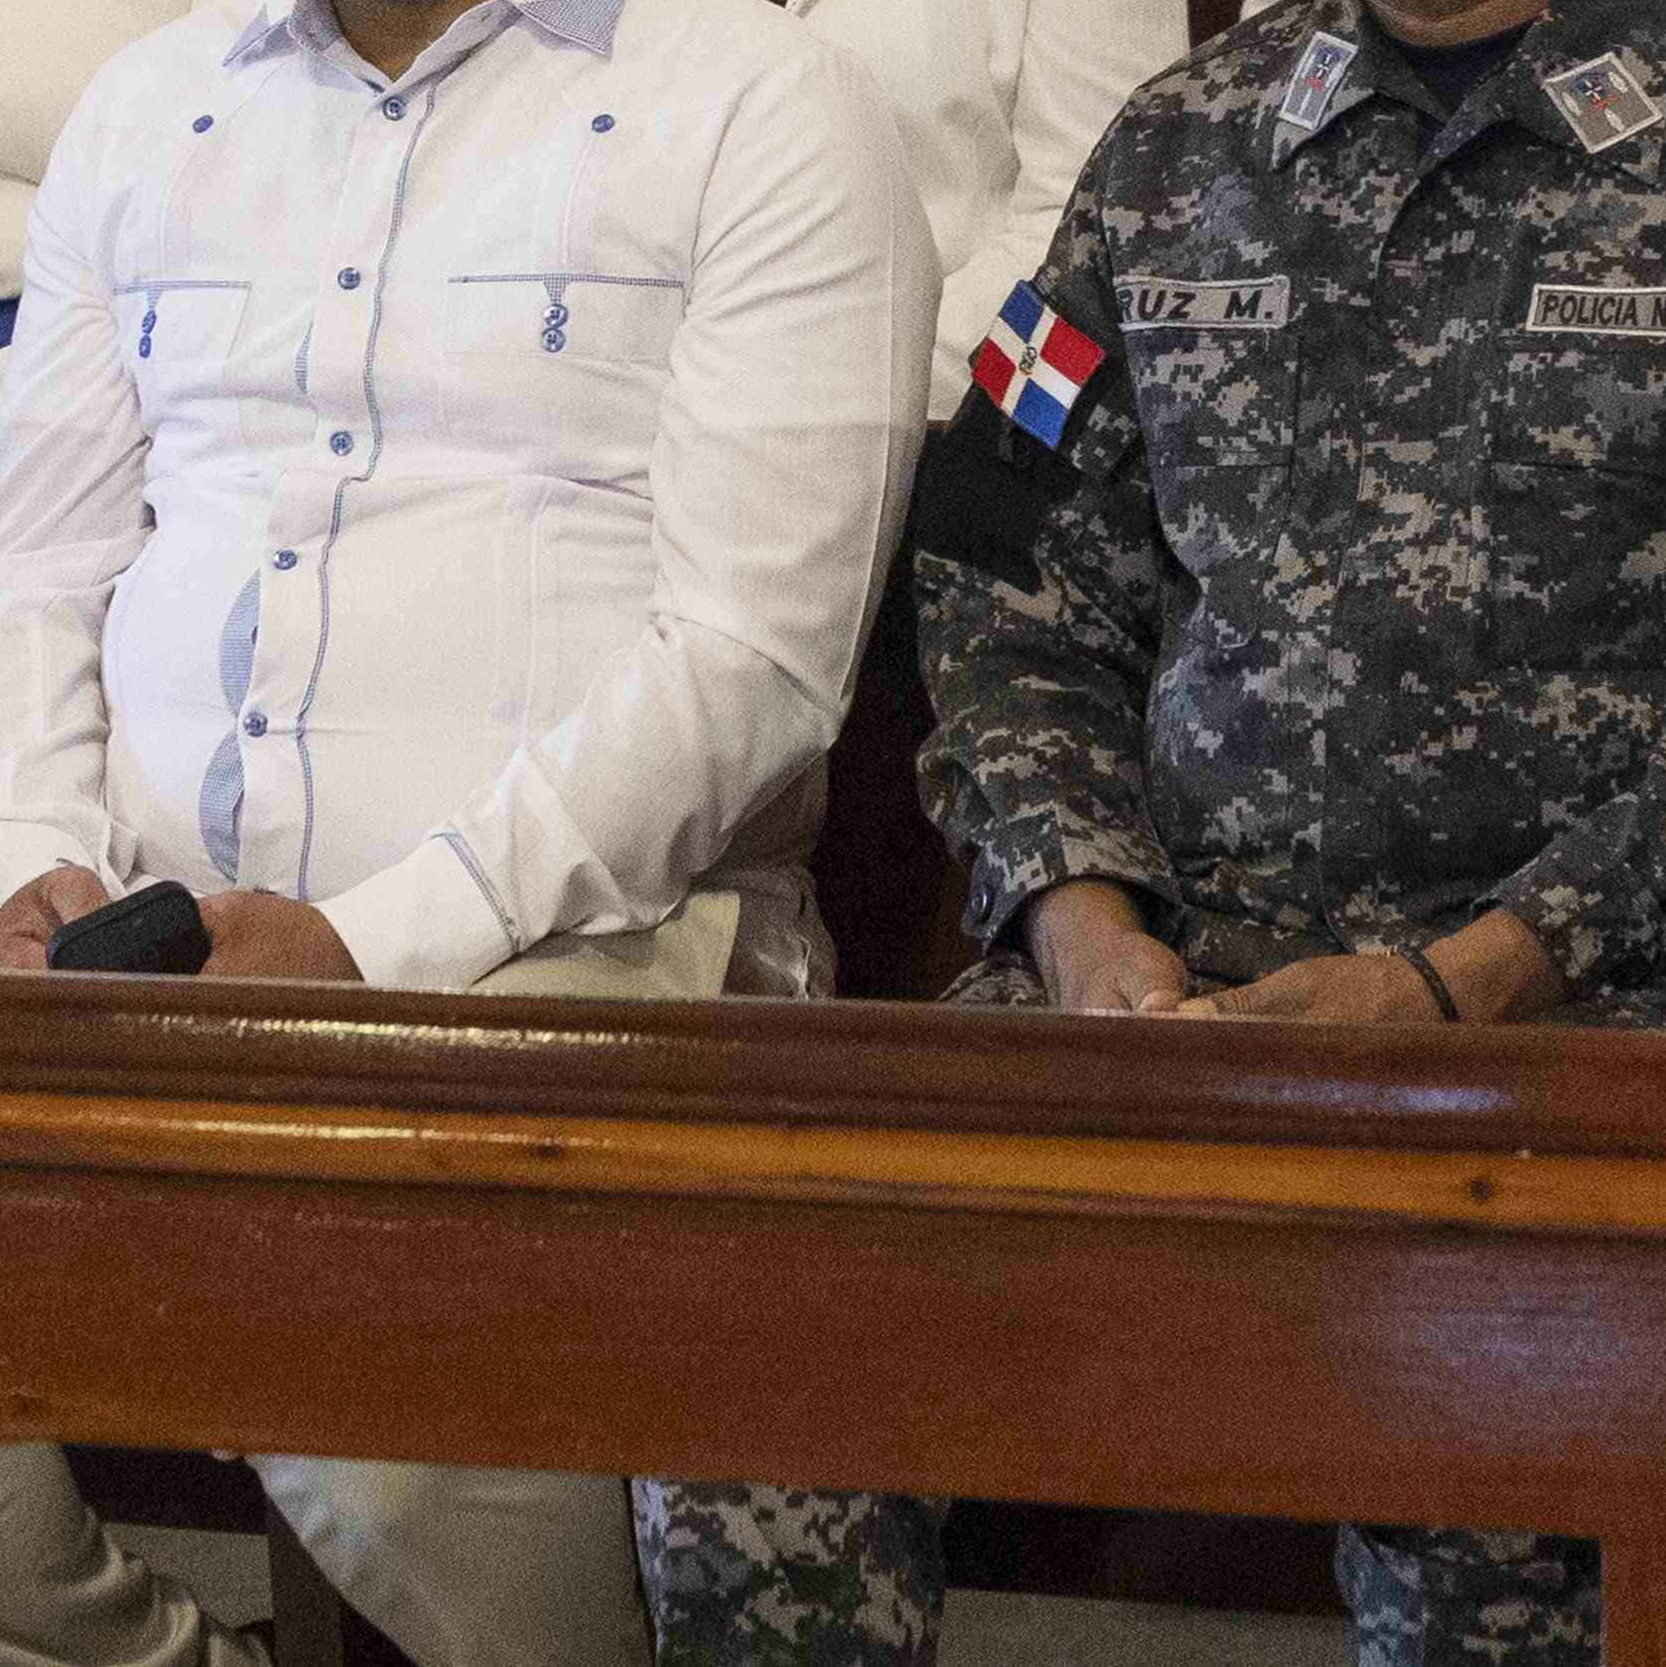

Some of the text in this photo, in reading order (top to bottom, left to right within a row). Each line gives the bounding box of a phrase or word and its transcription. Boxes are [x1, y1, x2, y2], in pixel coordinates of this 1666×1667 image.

[1116, 287, 1274, 322] RUZ M.
[1540, 294, 1638, 327] POLICIA
